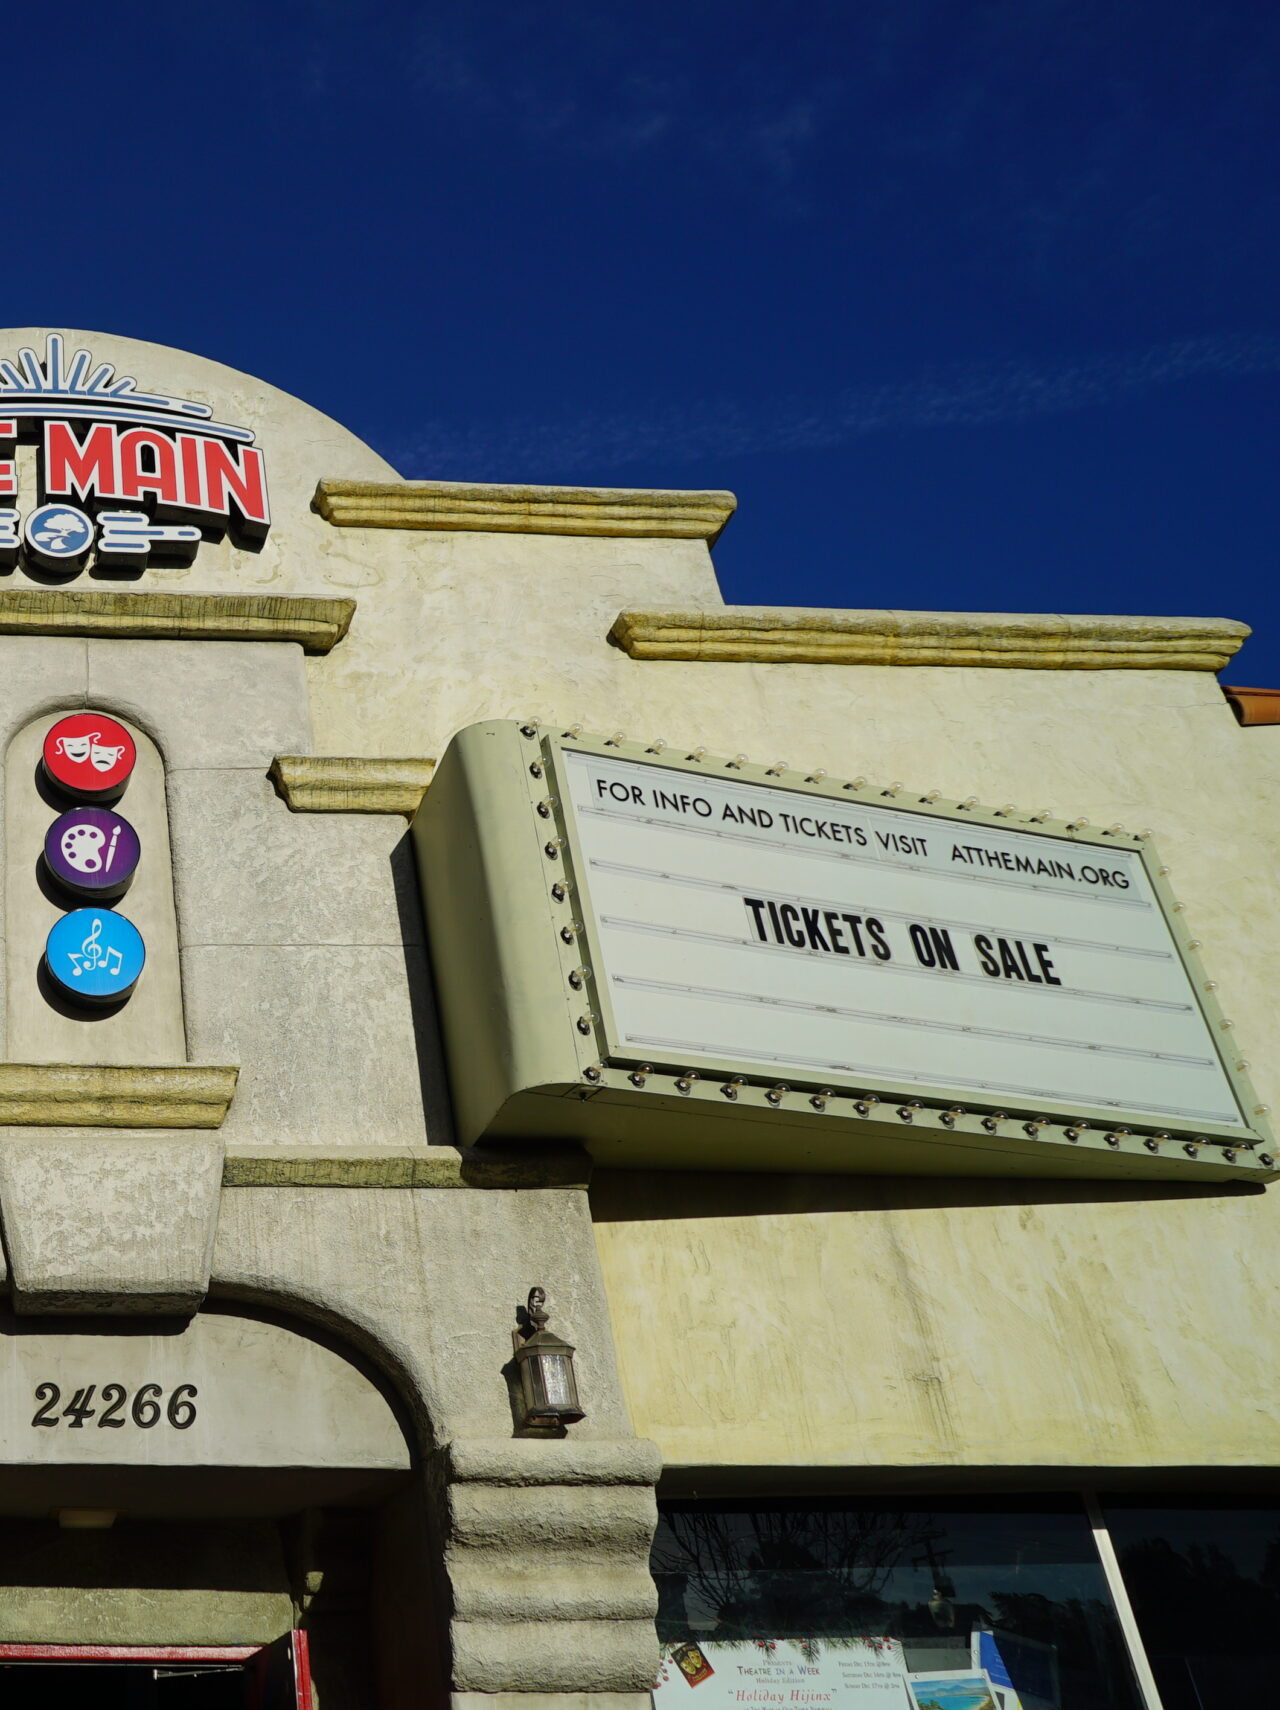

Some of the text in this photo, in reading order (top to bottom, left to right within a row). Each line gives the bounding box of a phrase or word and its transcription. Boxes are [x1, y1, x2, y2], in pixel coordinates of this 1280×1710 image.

[43, 420, 271, 526] MAIN
[596, 780, 1130, 890] FOR INFO AND TICKETS VISIT ATTHEMAIN.ORG
[743, 897, 1062, 986] TICKETS ON SALE
[31, 1382, 198, 1430] 24266
